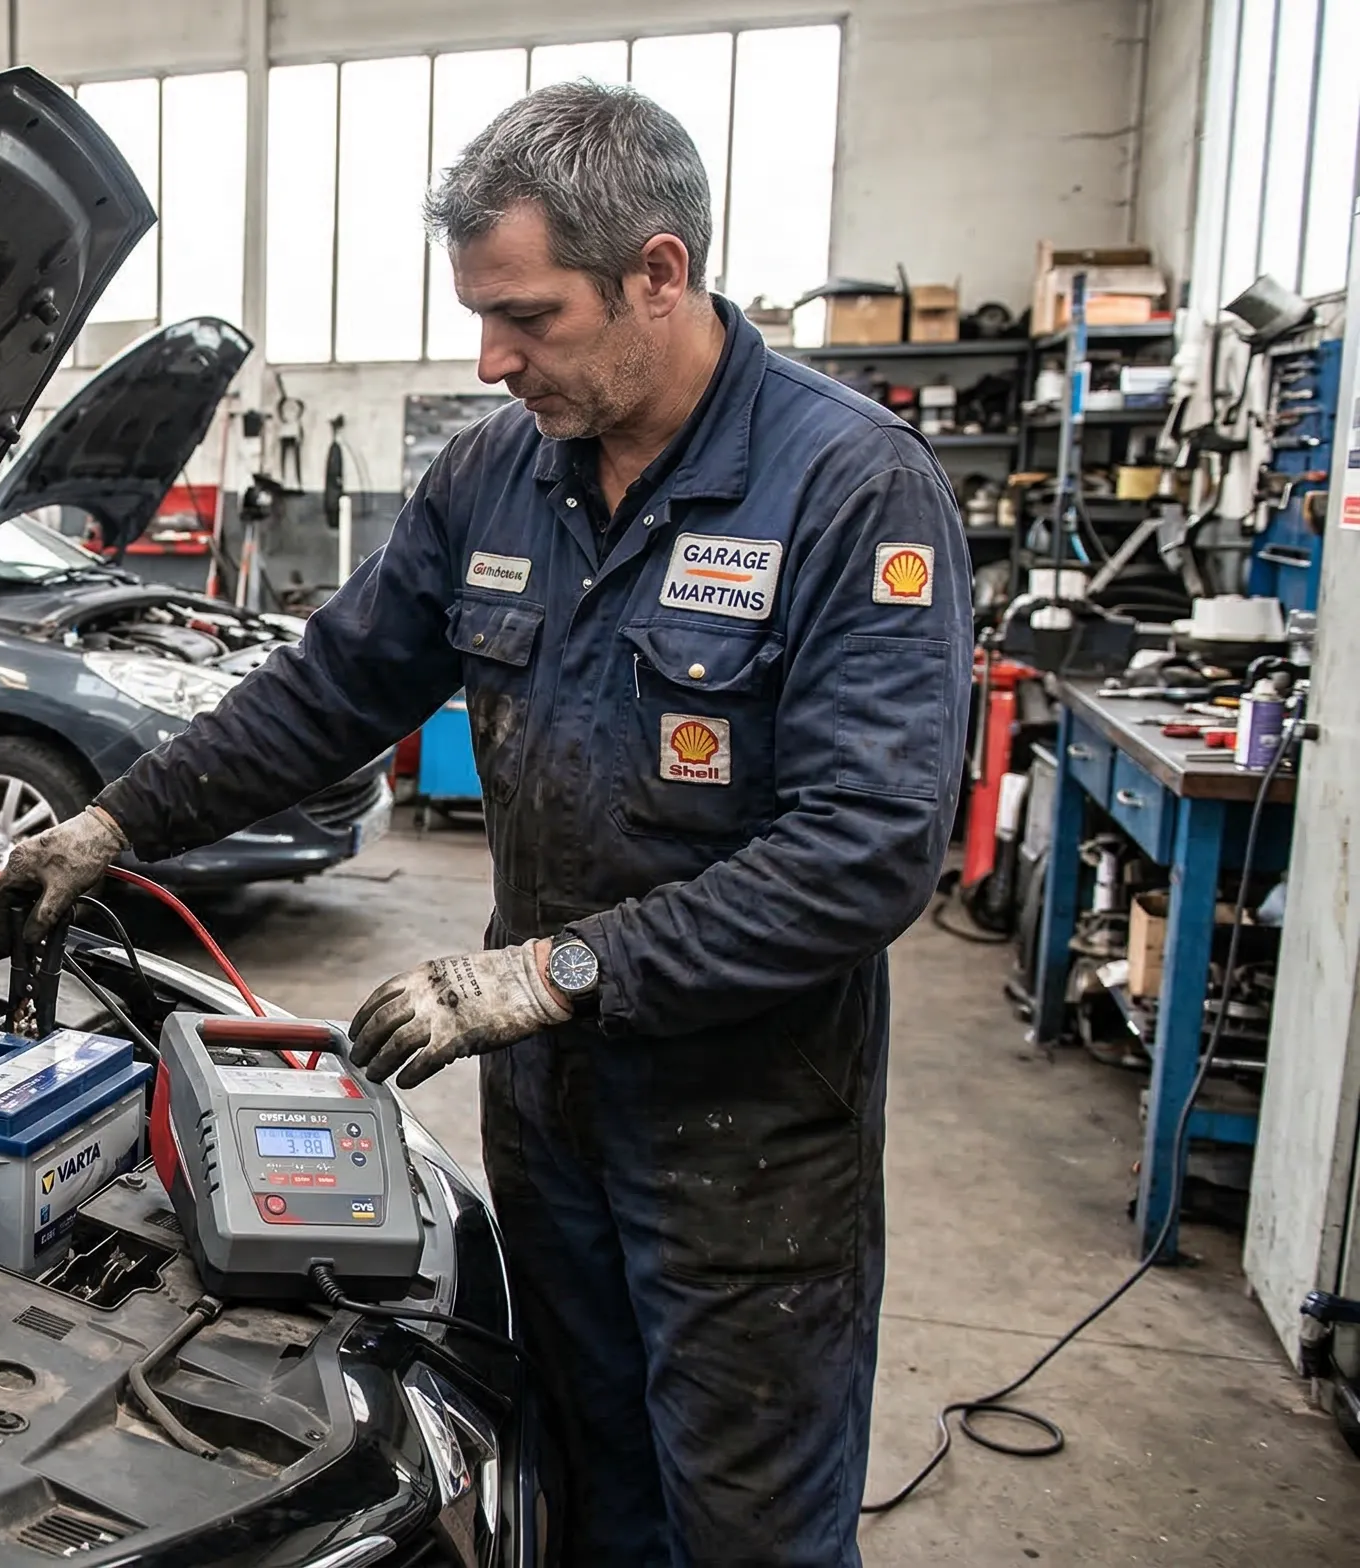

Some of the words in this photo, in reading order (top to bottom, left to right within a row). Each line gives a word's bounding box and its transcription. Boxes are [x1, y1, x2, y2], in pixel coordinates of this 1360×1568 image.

[683, 544, 771, 570] GARAGE
[666, 581, 765, 611] MARTINS
[669, 764, 719, 779] Shell
[57, 1142, 101, 1183] VARTA
